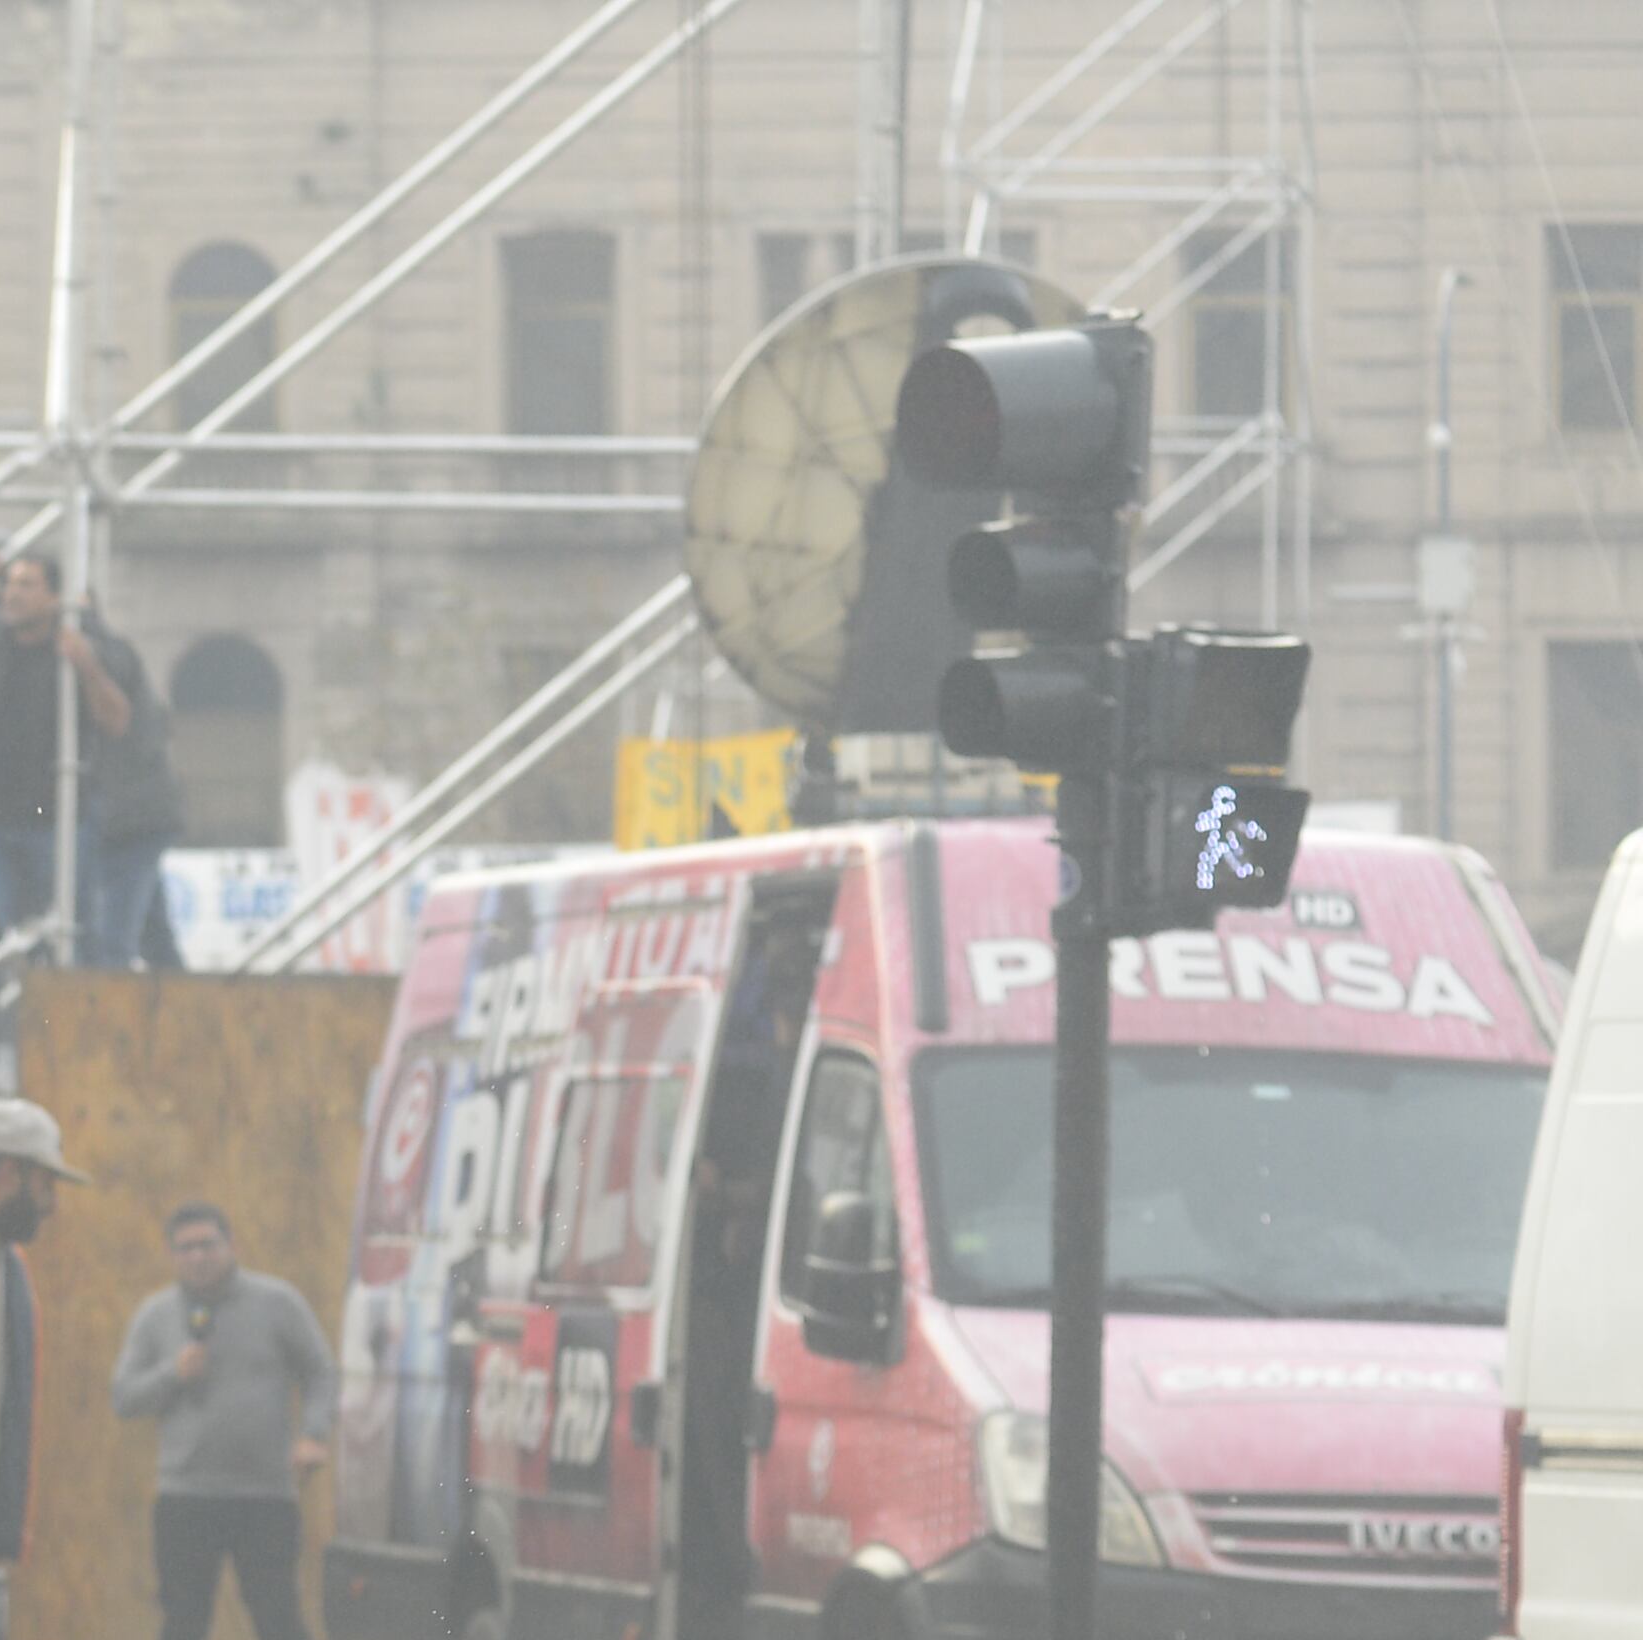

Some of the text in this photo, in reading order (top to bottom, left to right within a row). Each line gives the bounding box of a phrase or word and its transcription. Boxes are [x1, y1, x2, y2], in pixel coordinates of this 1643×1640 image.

[1295, 892, 1355, 930] HD
[967, 930, 1495, 1028] PRENSA
[1348, 1518, 1501, 1554] IVECO
